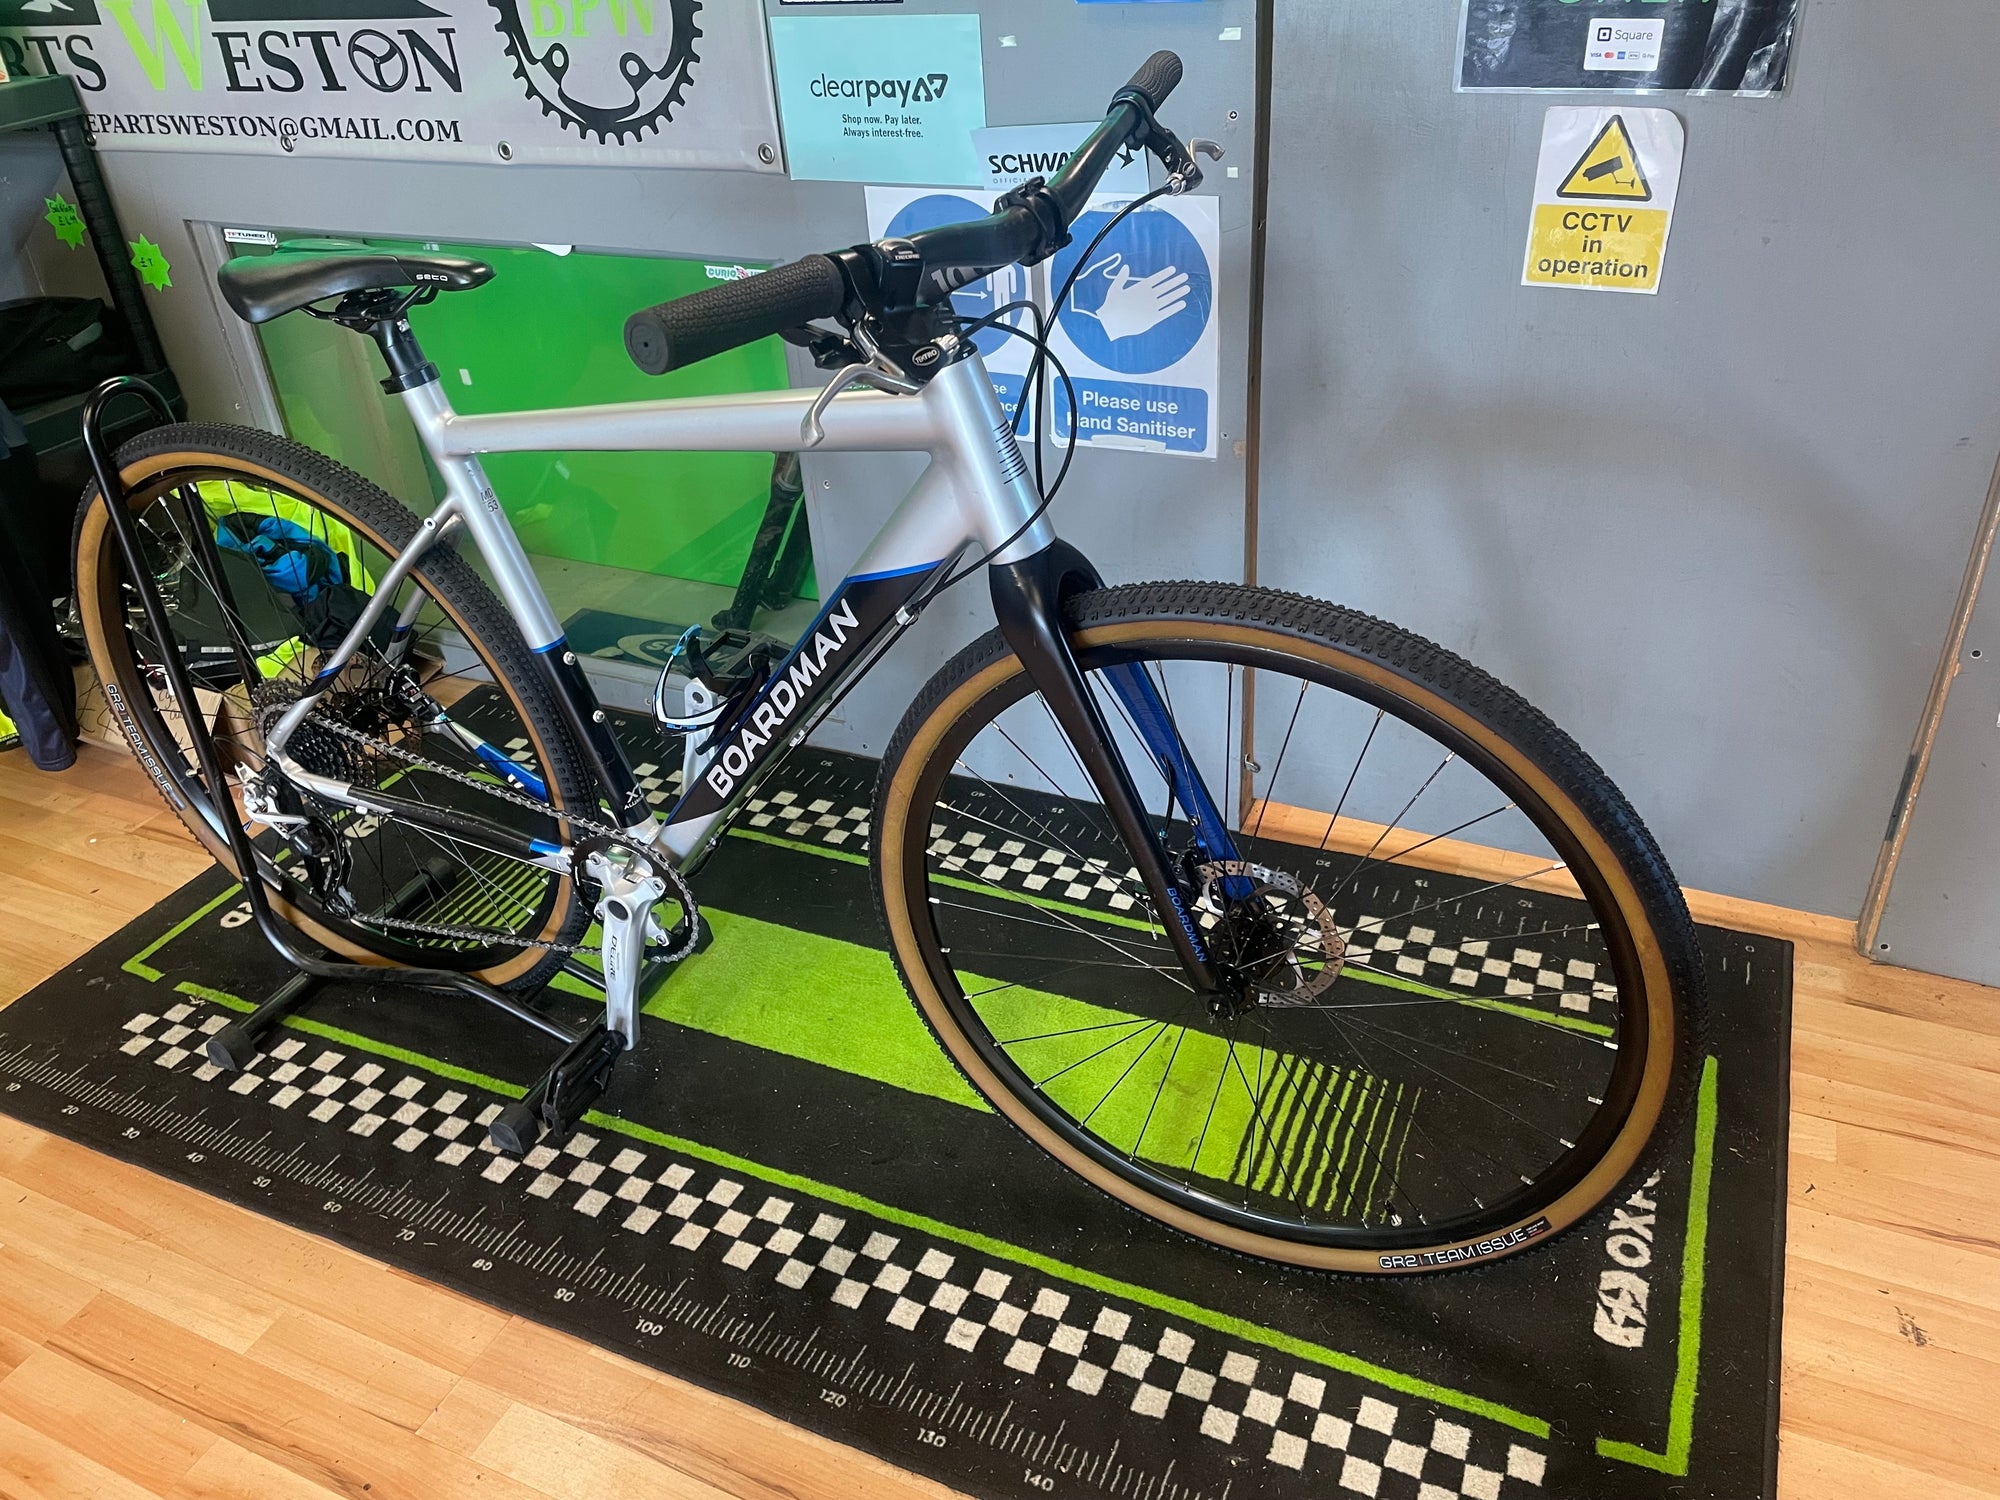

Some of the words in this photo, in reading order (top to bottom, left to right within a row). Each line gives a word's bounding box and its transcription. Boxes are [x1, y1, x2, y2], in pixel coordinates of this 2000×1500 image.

[1614, 29, 1653, 42] Square
[810, 73, 911, 108] clearpay
[86, 113, 463, 142] EPARTSWESTON@GMAIL.COM
[842, 114, 861, 125] Shop
[885, 114, 899, 126] Pay
[901, 115, 922, 125] later.
[843, 127, 870, 138] Always
[872, 128, 924, 138] interest-free.
[988, 151, 1100, 174] SCHWA
[1562, 211, 1633, 233] CCTV
[1582, 235, 1602, 253] in
[1538, 256, 1648, 279] operation
[914, 349, 938, 364] TEKTRO
[1082, 390, 1141, 411] Please
[1146, 400, 1179, 415] use
[1117, 417, 1197, 439] Sanitiser
[487, 499, 499, 512] 53
[706, 598, 860, 800] BOARDMAN
[107, 684, 126, 712] GR2
[123, 716, 148, 756] TEAM
[143, 755, 174, 793] ISSUE
[1167, 887, 1208, 962] BOARDMAN
[6, 1082, 21, 1092] 10
[61, 1105, 79, 1115] 20
[122, 1127, 141, 1139] 30
[186, 1152, 204, 1163] 40
[253, 1176, 271, 1189] 50
[323, 1200, 342, 1213] 60
[396, 1227, 416, 1242] 70
[1380, 1256, 1418, 1269] GR2
[1424, 1248, 1474, 1266] TEAM
[1476, 1227, 1528, 1255] ISSUE
[472, 1257, 493, 1271] 80
[554, 1287, 576, 1303] 90
[635, 1318, 664, 1337] 100
[726, 1352, 751, 1369] 110
[820, 1388, 847, 1408] 120
[916, 1427, 948, 1448] 130
[1024, 1468, 1055, 1492] 140
